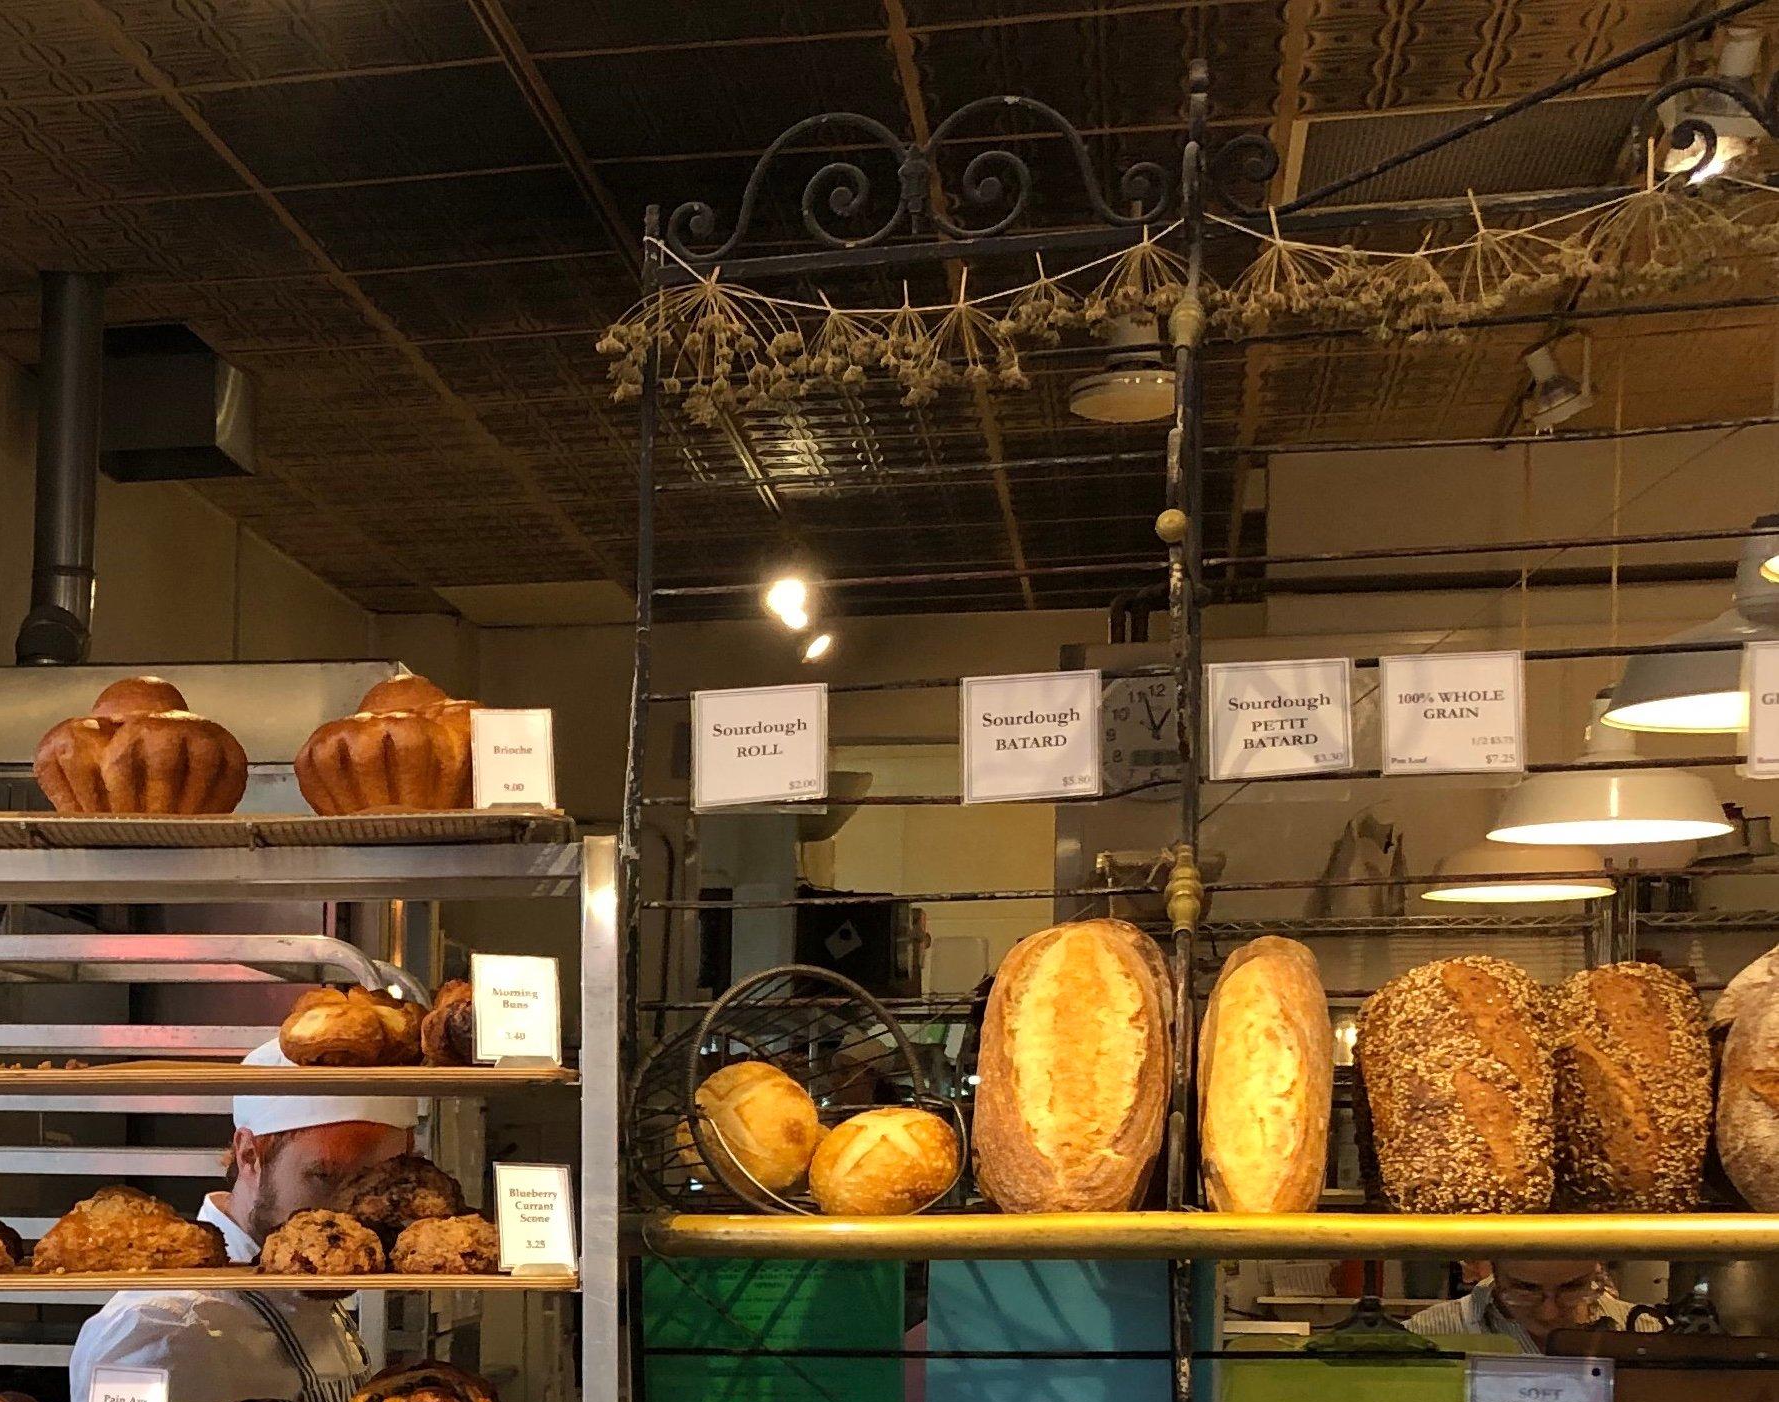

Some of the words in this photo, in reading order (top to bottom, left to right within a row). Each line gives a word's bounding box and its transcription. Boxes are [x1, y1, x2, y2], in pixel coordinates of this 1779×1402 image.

[1148, 683, 1165, 697] 12
[1228, 693, 1331, 711] Sourdough
[1398, 692, 1434, 704] 100%
[1438, 690, 1505, 702] WHOLE
[982, 707, 1080, 727] Sourdough
[1423, 707, 1479, 719] GRAIN
[712, 718, 807, 737] Sourdough
[1252, 717, 1309, 731] PETIT
[996, 735, 1067, 750] BATARD
[1244, 733, 1318, 749] BATARD
[493, 745, 533, 755] Brioche
[737, 744, 783, 757] ROLL
[492, 987, 538, 1000] Morning
[502, 1000, 528, 1009] Buns
[509, 1188, 558, 1201] Blueberry
[515, 1201, 554, 1211] Currant
[520, 1213, 551, 1223] Scone
[1519, 1387, 1564, 1400] SOFT
